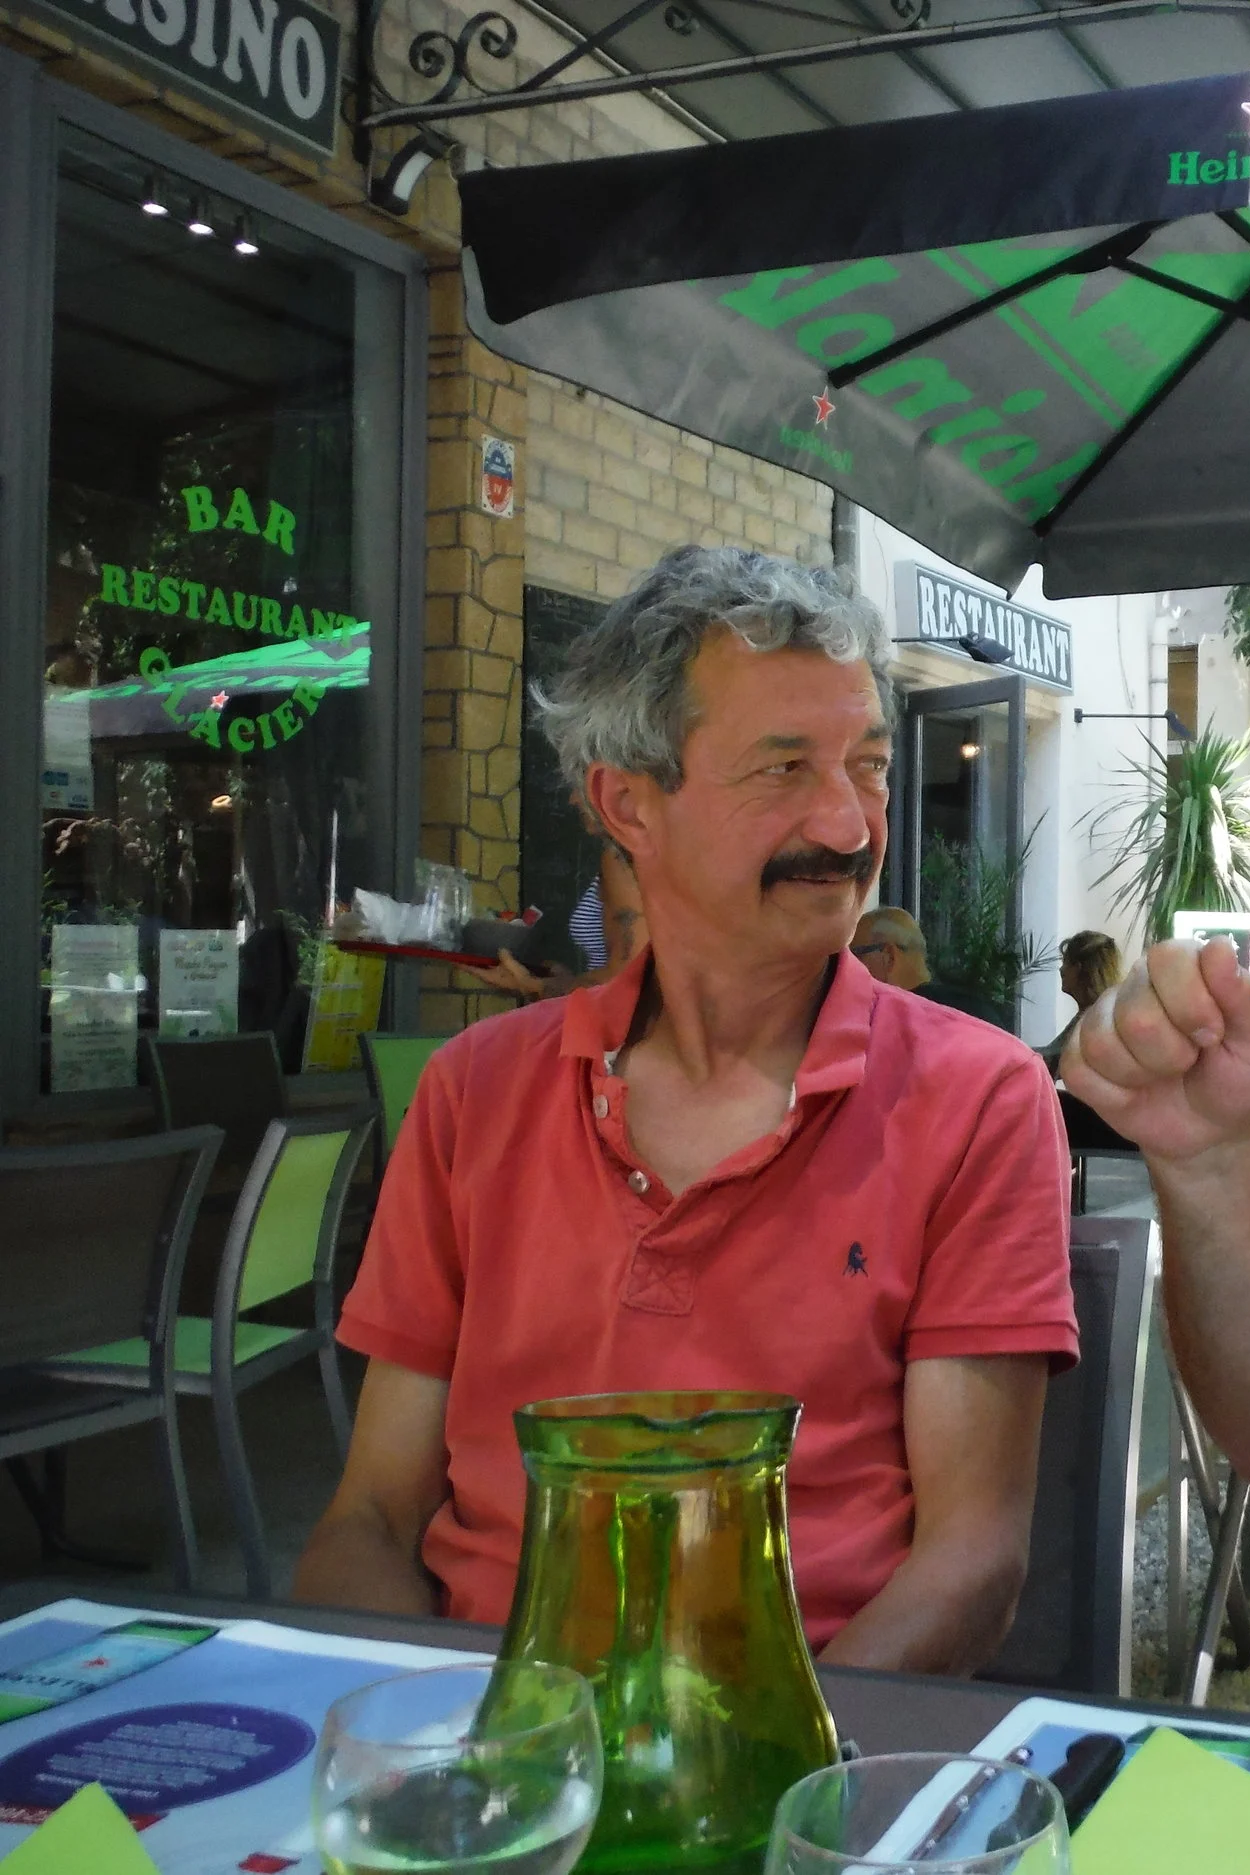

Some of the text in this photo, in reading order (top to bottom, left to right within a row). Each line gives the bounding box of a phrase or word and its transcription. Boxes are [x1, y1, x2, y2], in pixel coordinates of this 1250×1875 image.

[181, 485, 296, 555] BAR
[101, 563, 358, 648] RESTAURANT
[919, 575, 1069, 681] RESTAURANT
[139, 646, 326, 753] GLACIER
